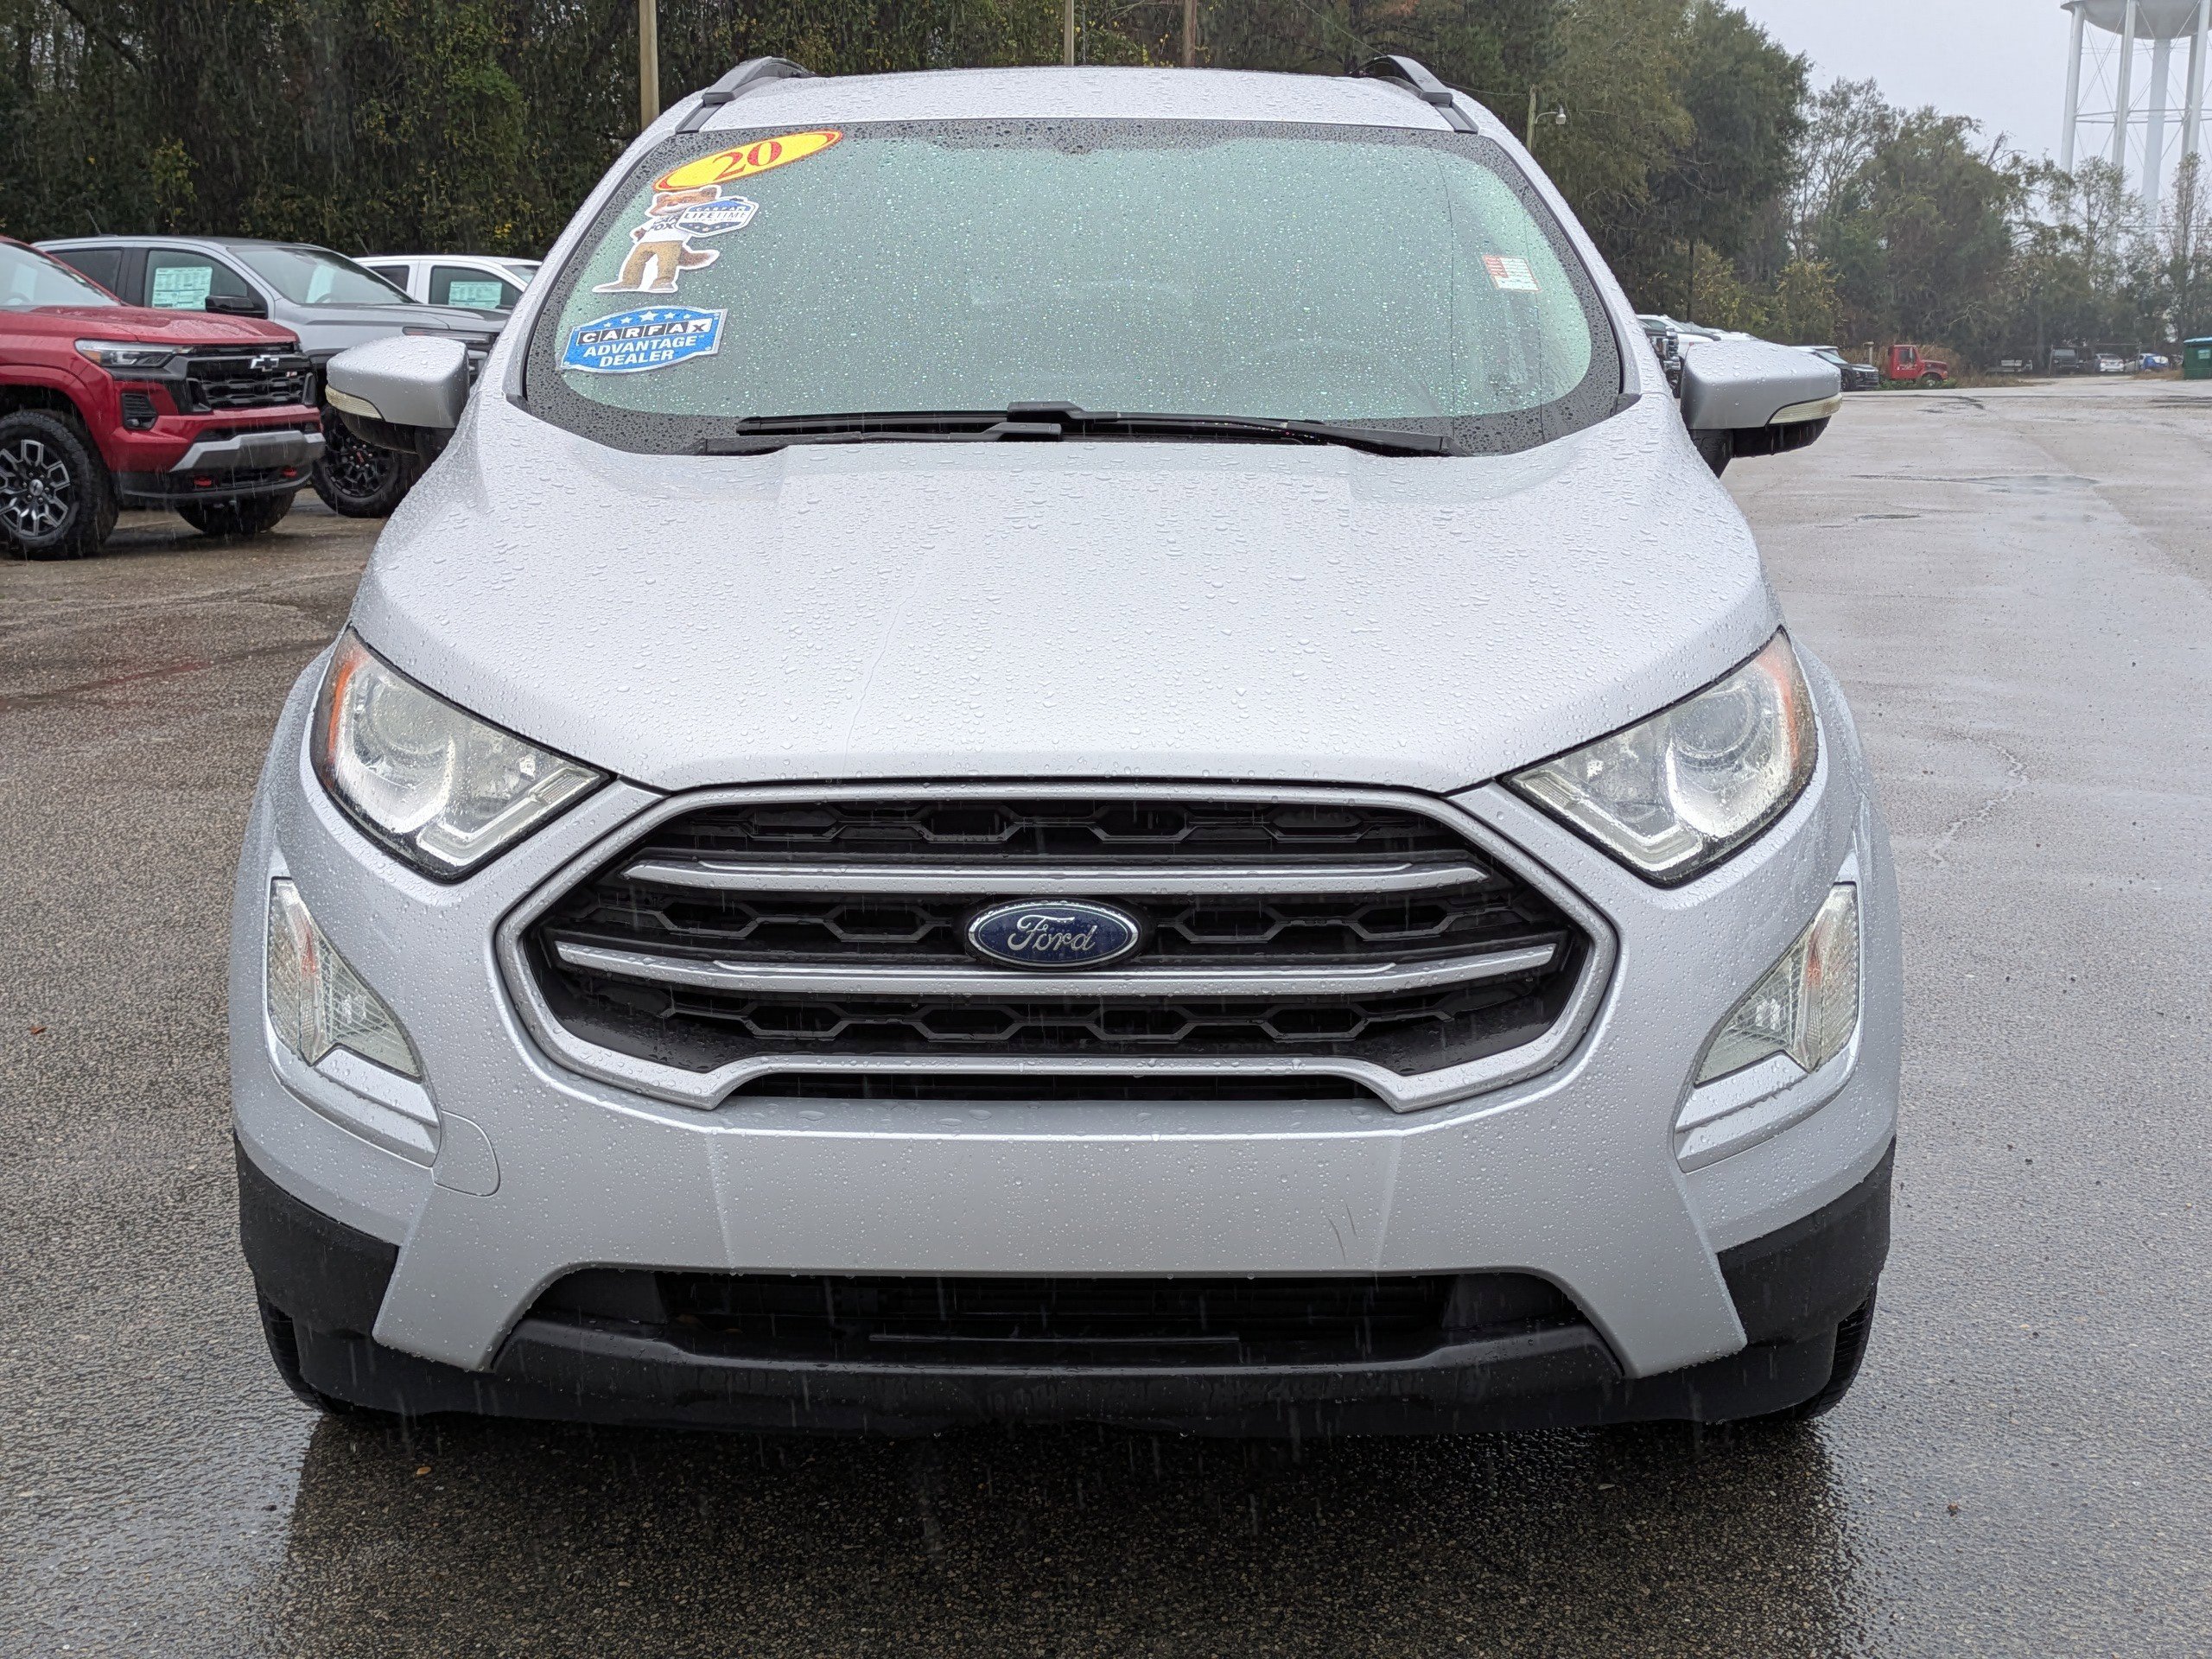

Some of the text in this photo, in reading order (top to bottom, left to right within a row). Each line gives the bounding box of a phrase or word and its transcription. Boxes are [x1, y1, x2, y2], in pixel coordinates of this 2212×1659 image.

[711, 140, 783, 181] 20
[648, 222, 677, 232] FOX
[580, 321, 710, 344] CARFAX
[582, 335, 698, 358] ADVANTAGE
[599, 349, 676, 367] DEALER
[1007, 914, 1097, 951] Ford
